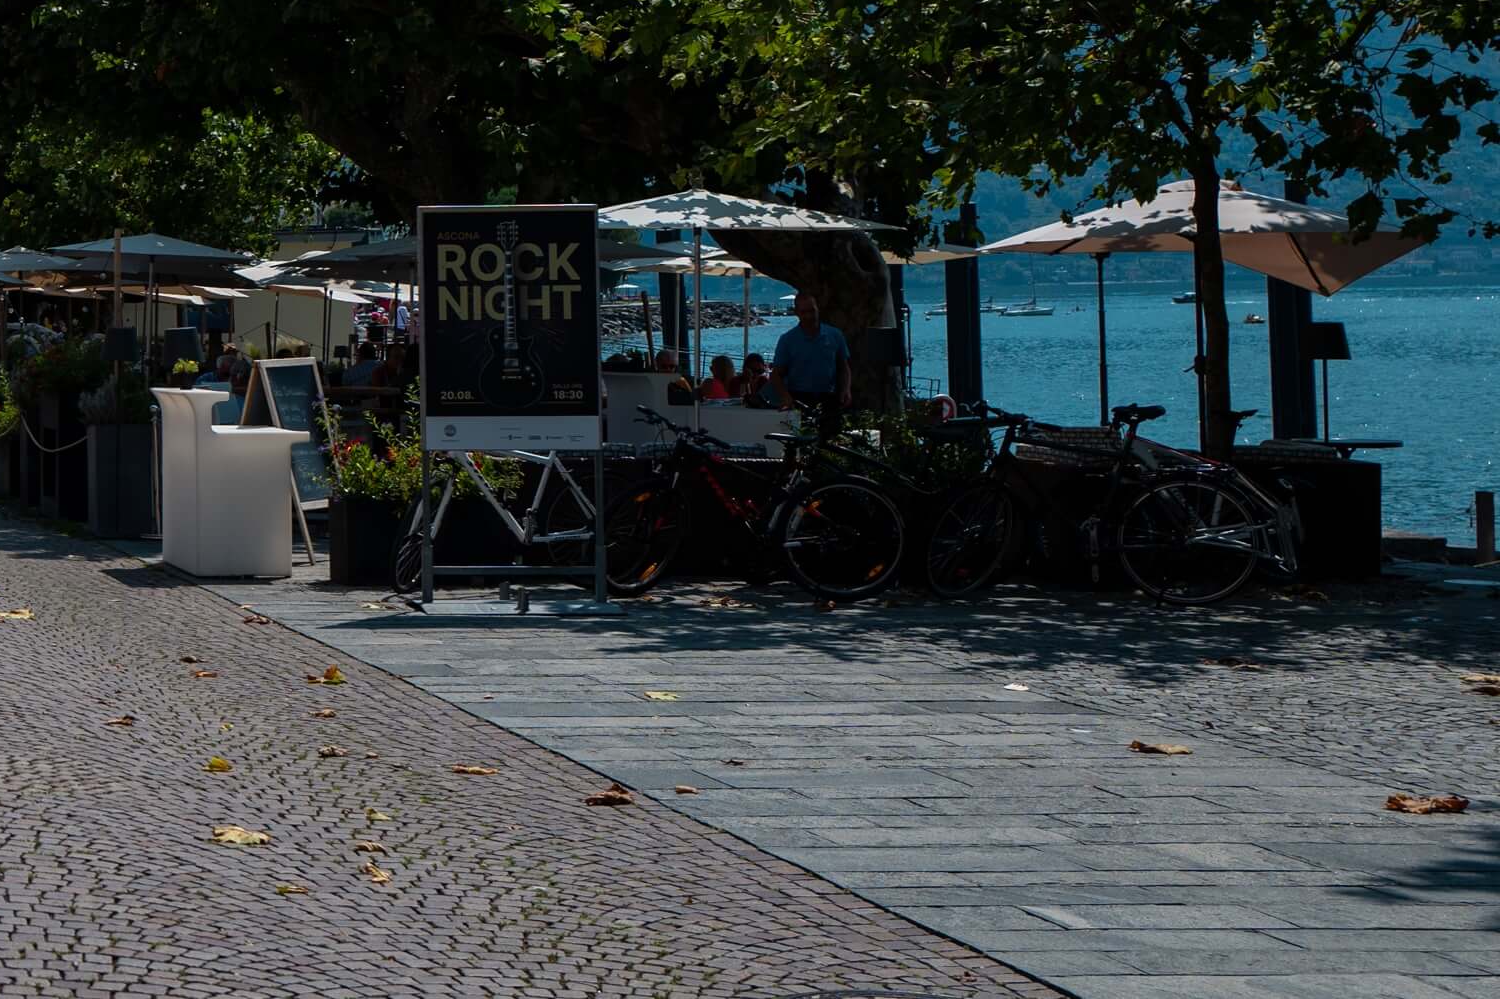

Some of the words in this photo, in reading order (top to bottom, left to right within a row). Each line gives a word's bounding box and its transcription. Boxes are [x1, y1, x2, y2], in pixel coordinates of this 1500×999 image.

[437, 231, 480, 240] ASCONA
[437, 242, 580, 282] ROCK
[437, 284, 581, 321] NIGHT
[440, 391, 474, 400] 20.08.
[553, 390, 583, 400] 18:30
